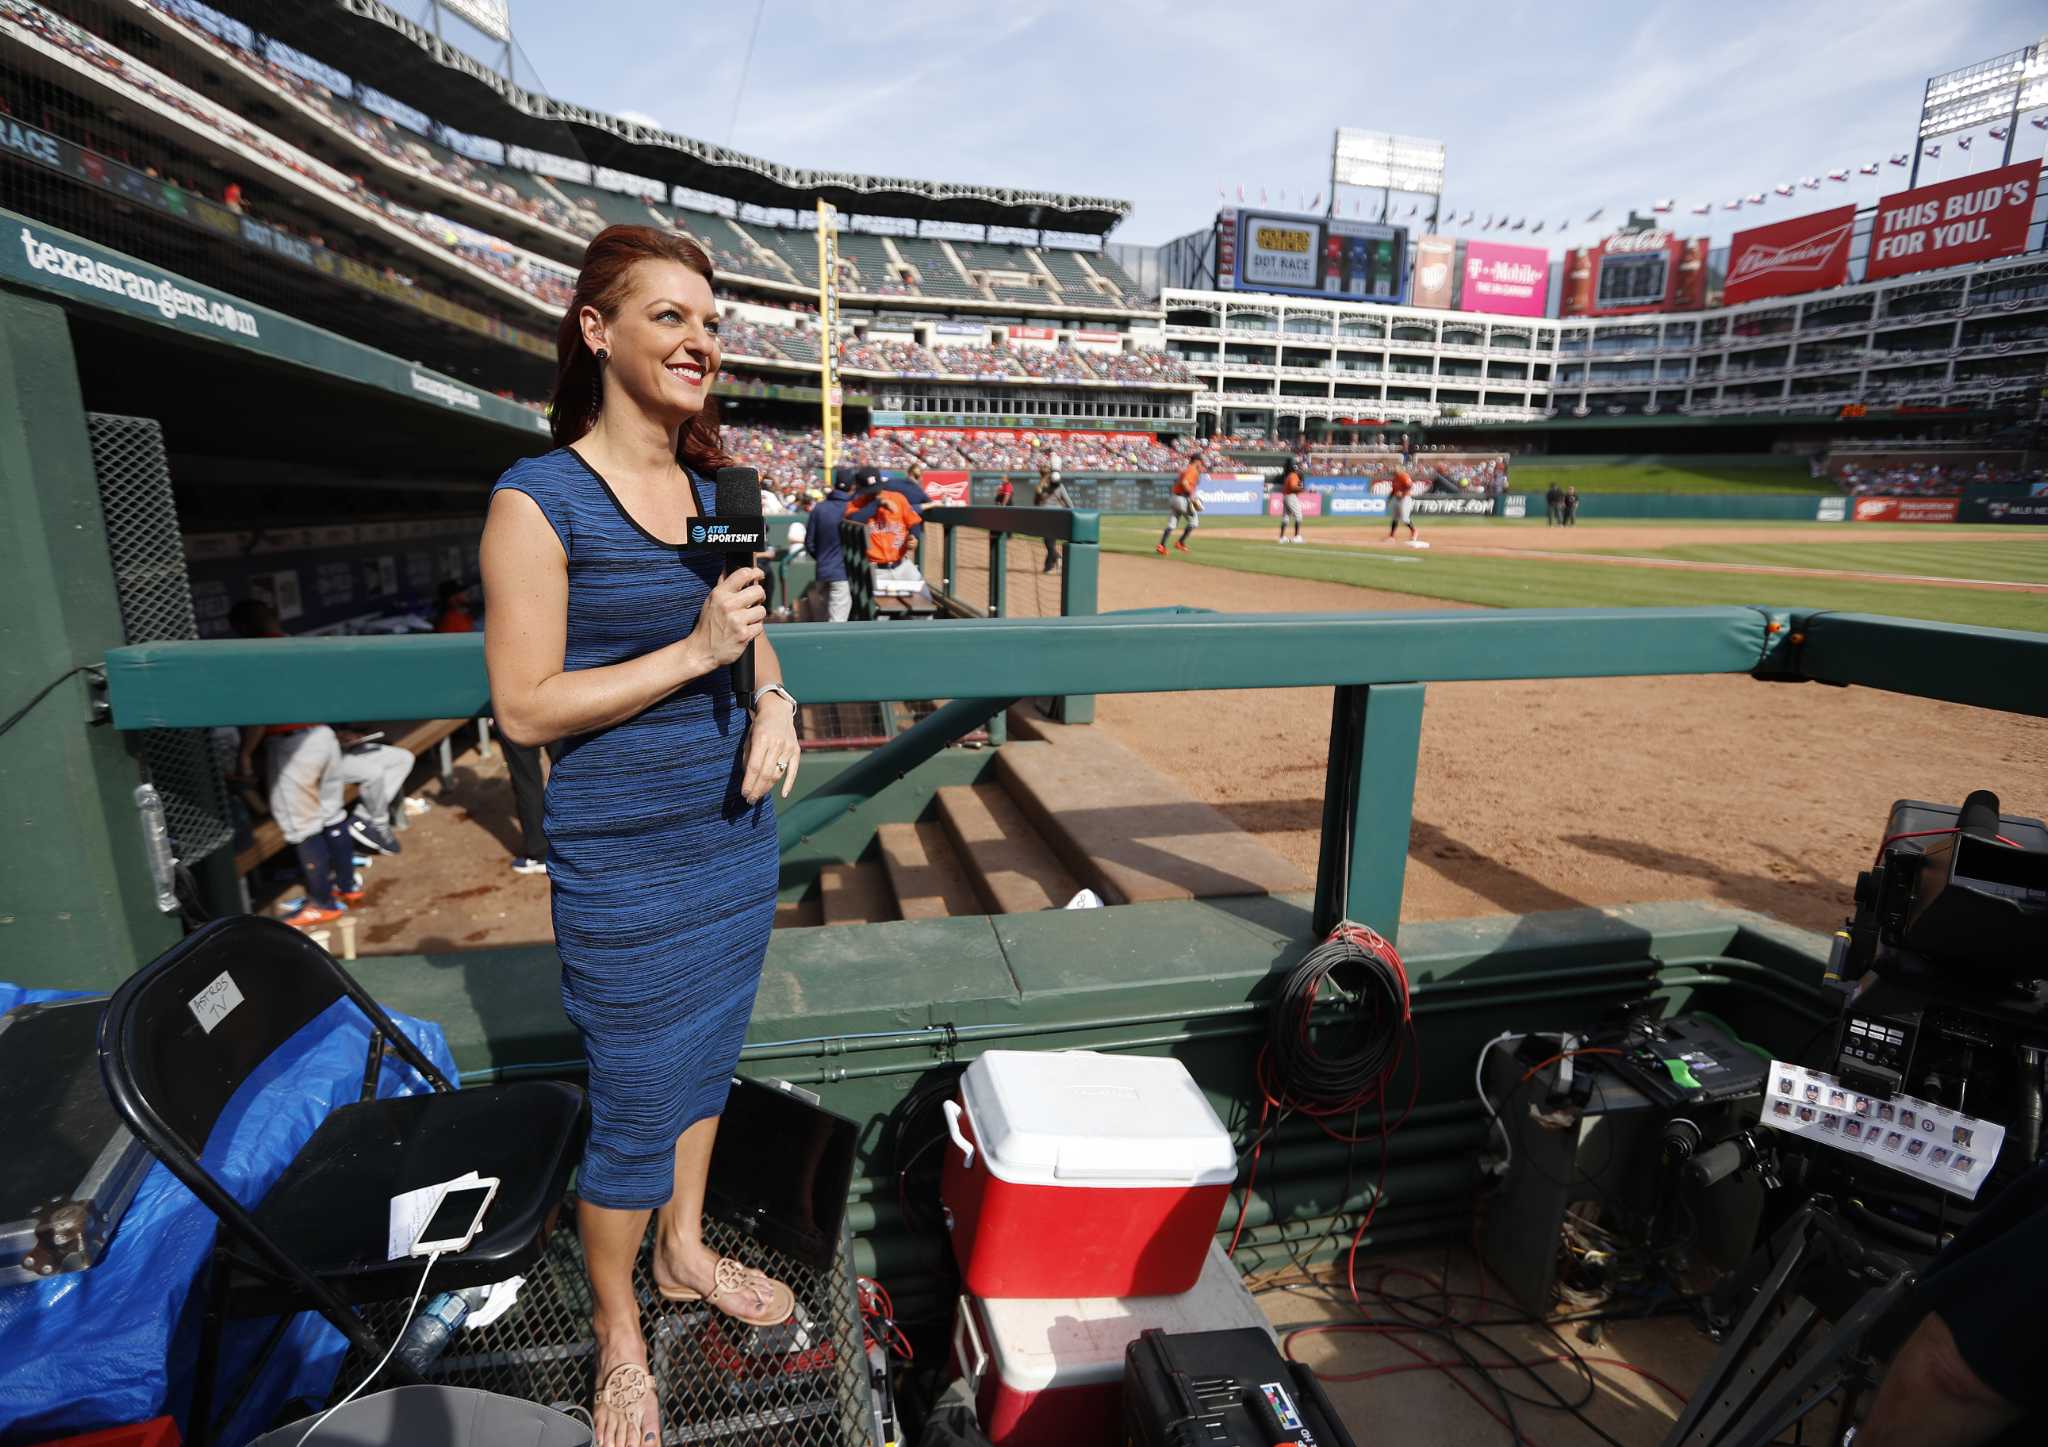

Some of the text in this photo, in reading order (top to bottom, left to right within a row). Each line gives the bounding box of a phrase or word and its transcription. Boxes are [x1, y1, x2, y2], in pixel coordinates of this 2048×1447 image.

[1882, 206, 1939, 233] THIS
[1874, 217, 1992, 262] FOR YOU.
[20, 228, 260, 338] texasrangers.com
[707, 525, 729, 533] AT&T
[707, 533, 758, 542] SPORTSNET
